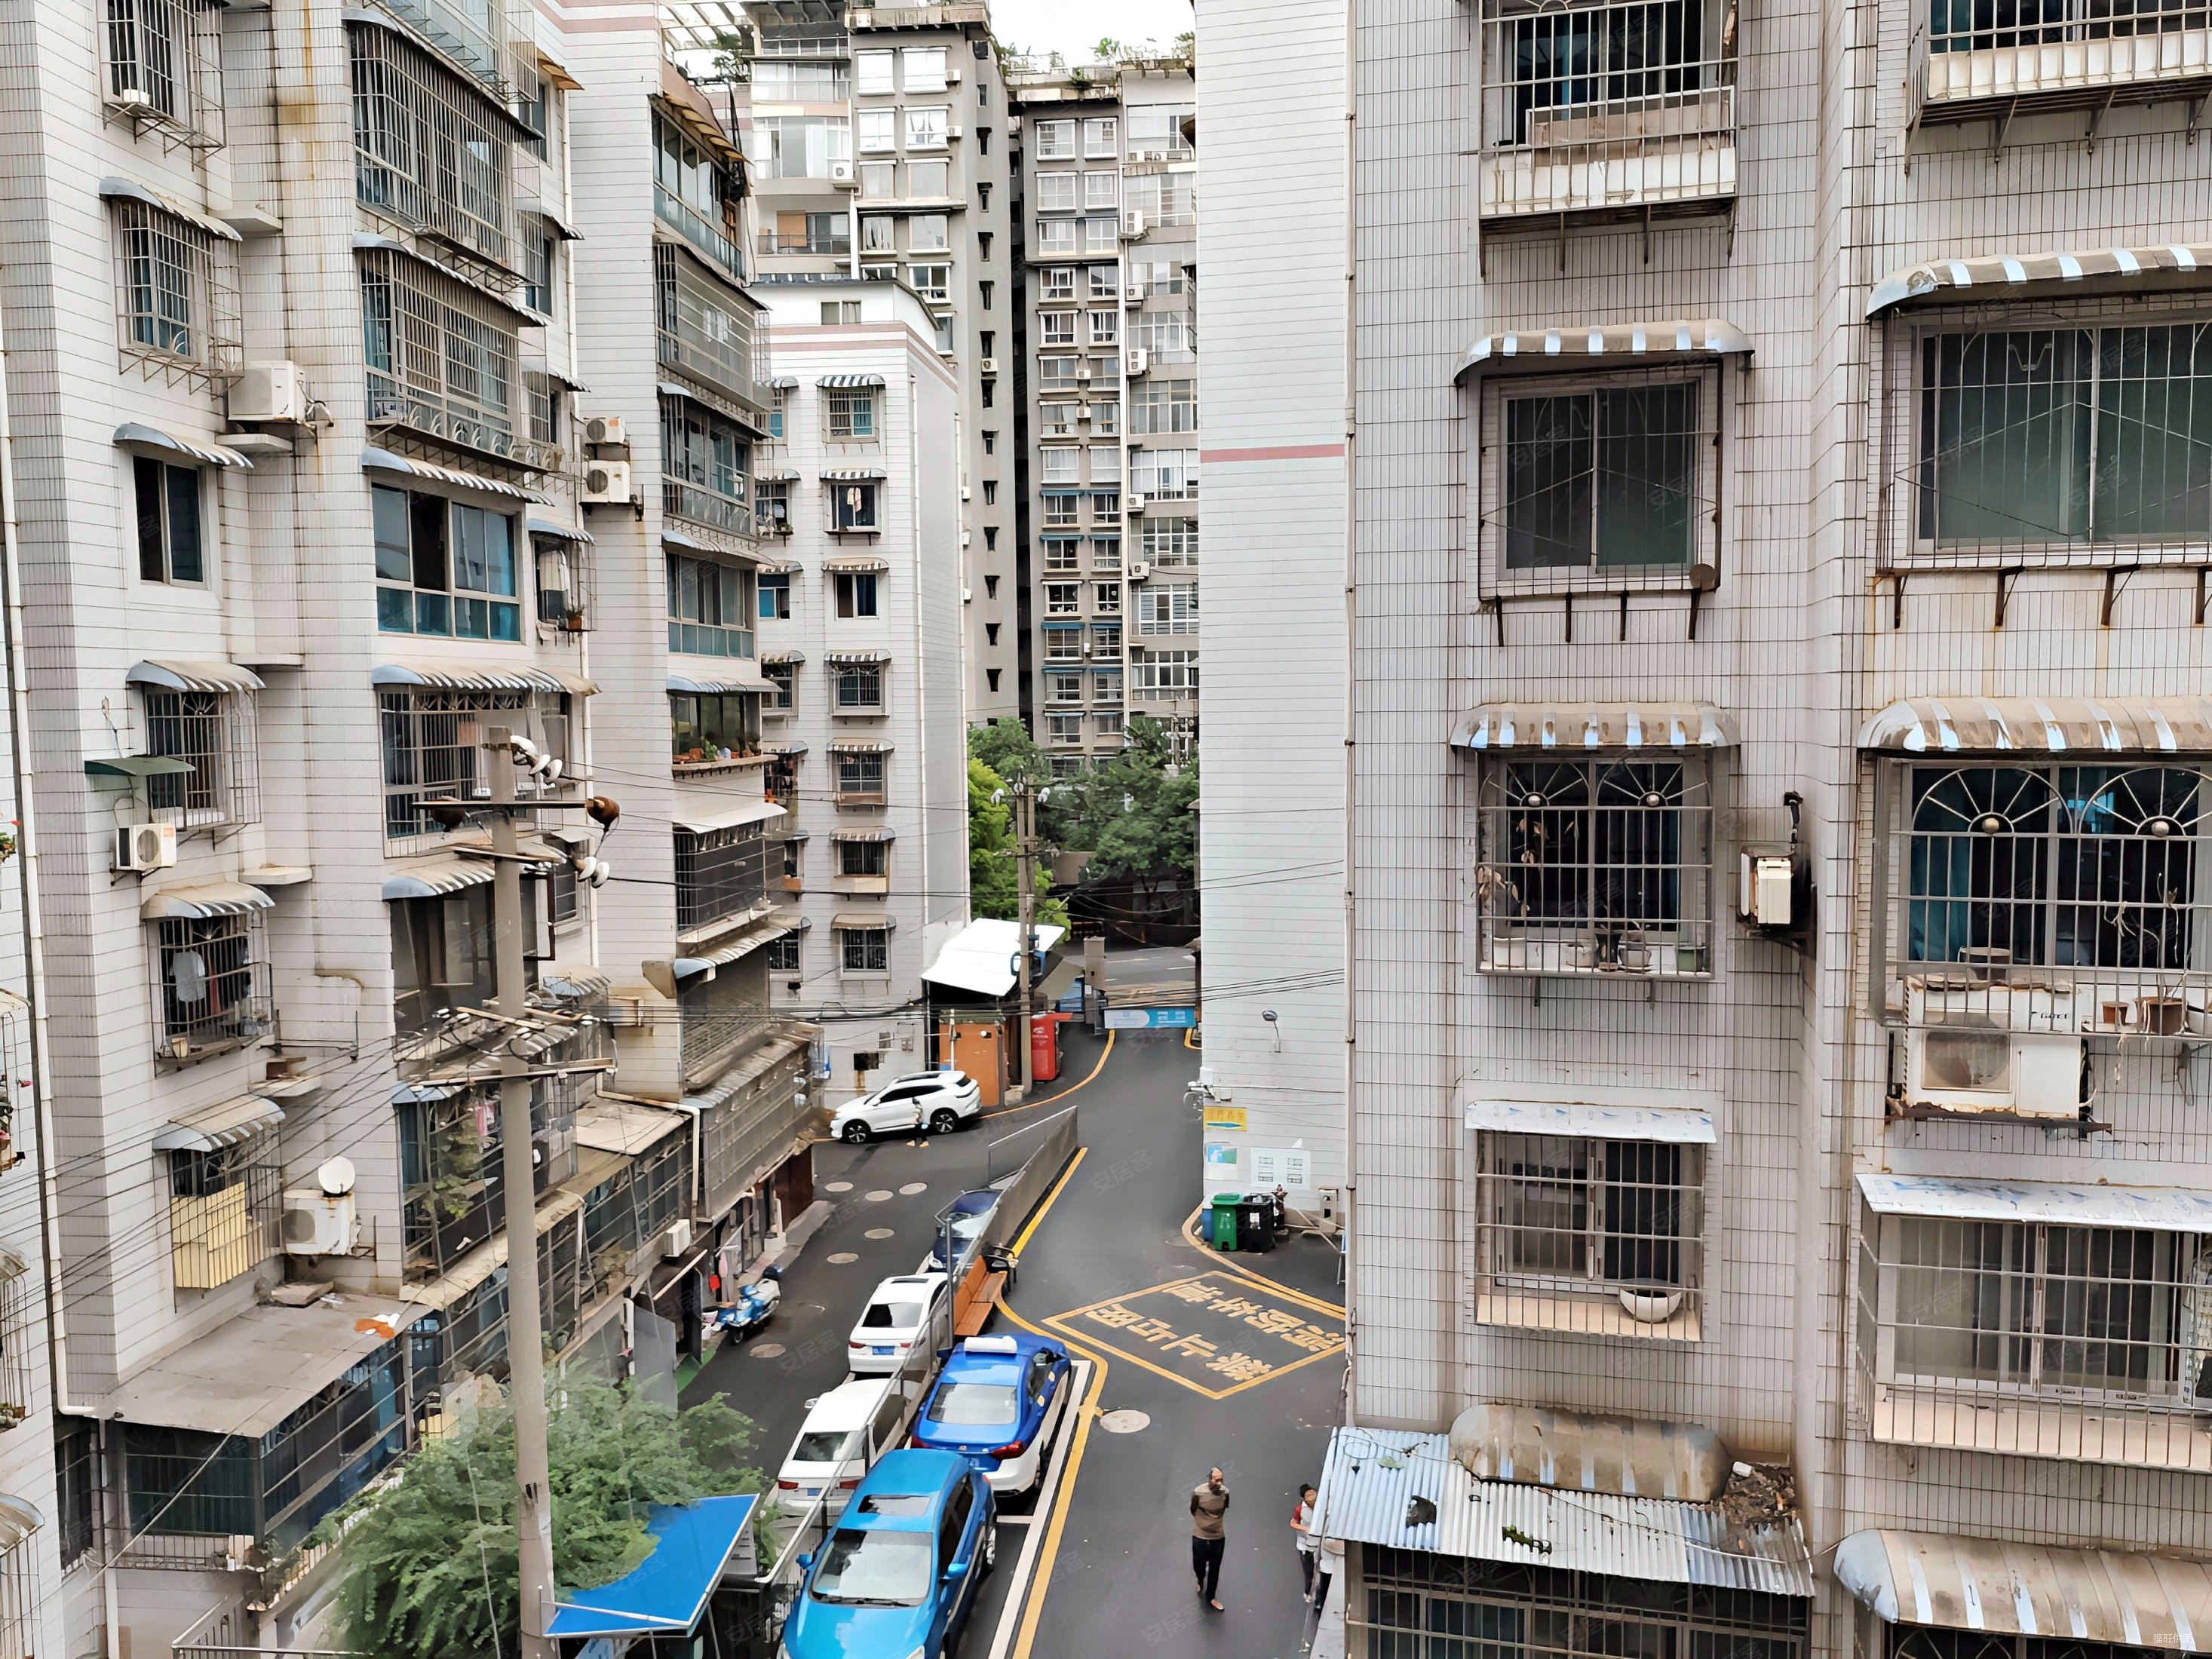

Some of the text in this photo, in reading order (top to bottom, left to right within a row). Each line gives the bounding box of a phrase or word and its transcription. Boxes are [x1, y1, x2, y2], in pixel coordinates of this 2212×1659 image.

[1085, 1303, 1273, 1381] 禁止占用
[1162, 1280, 1345, 1351] 消防车道
